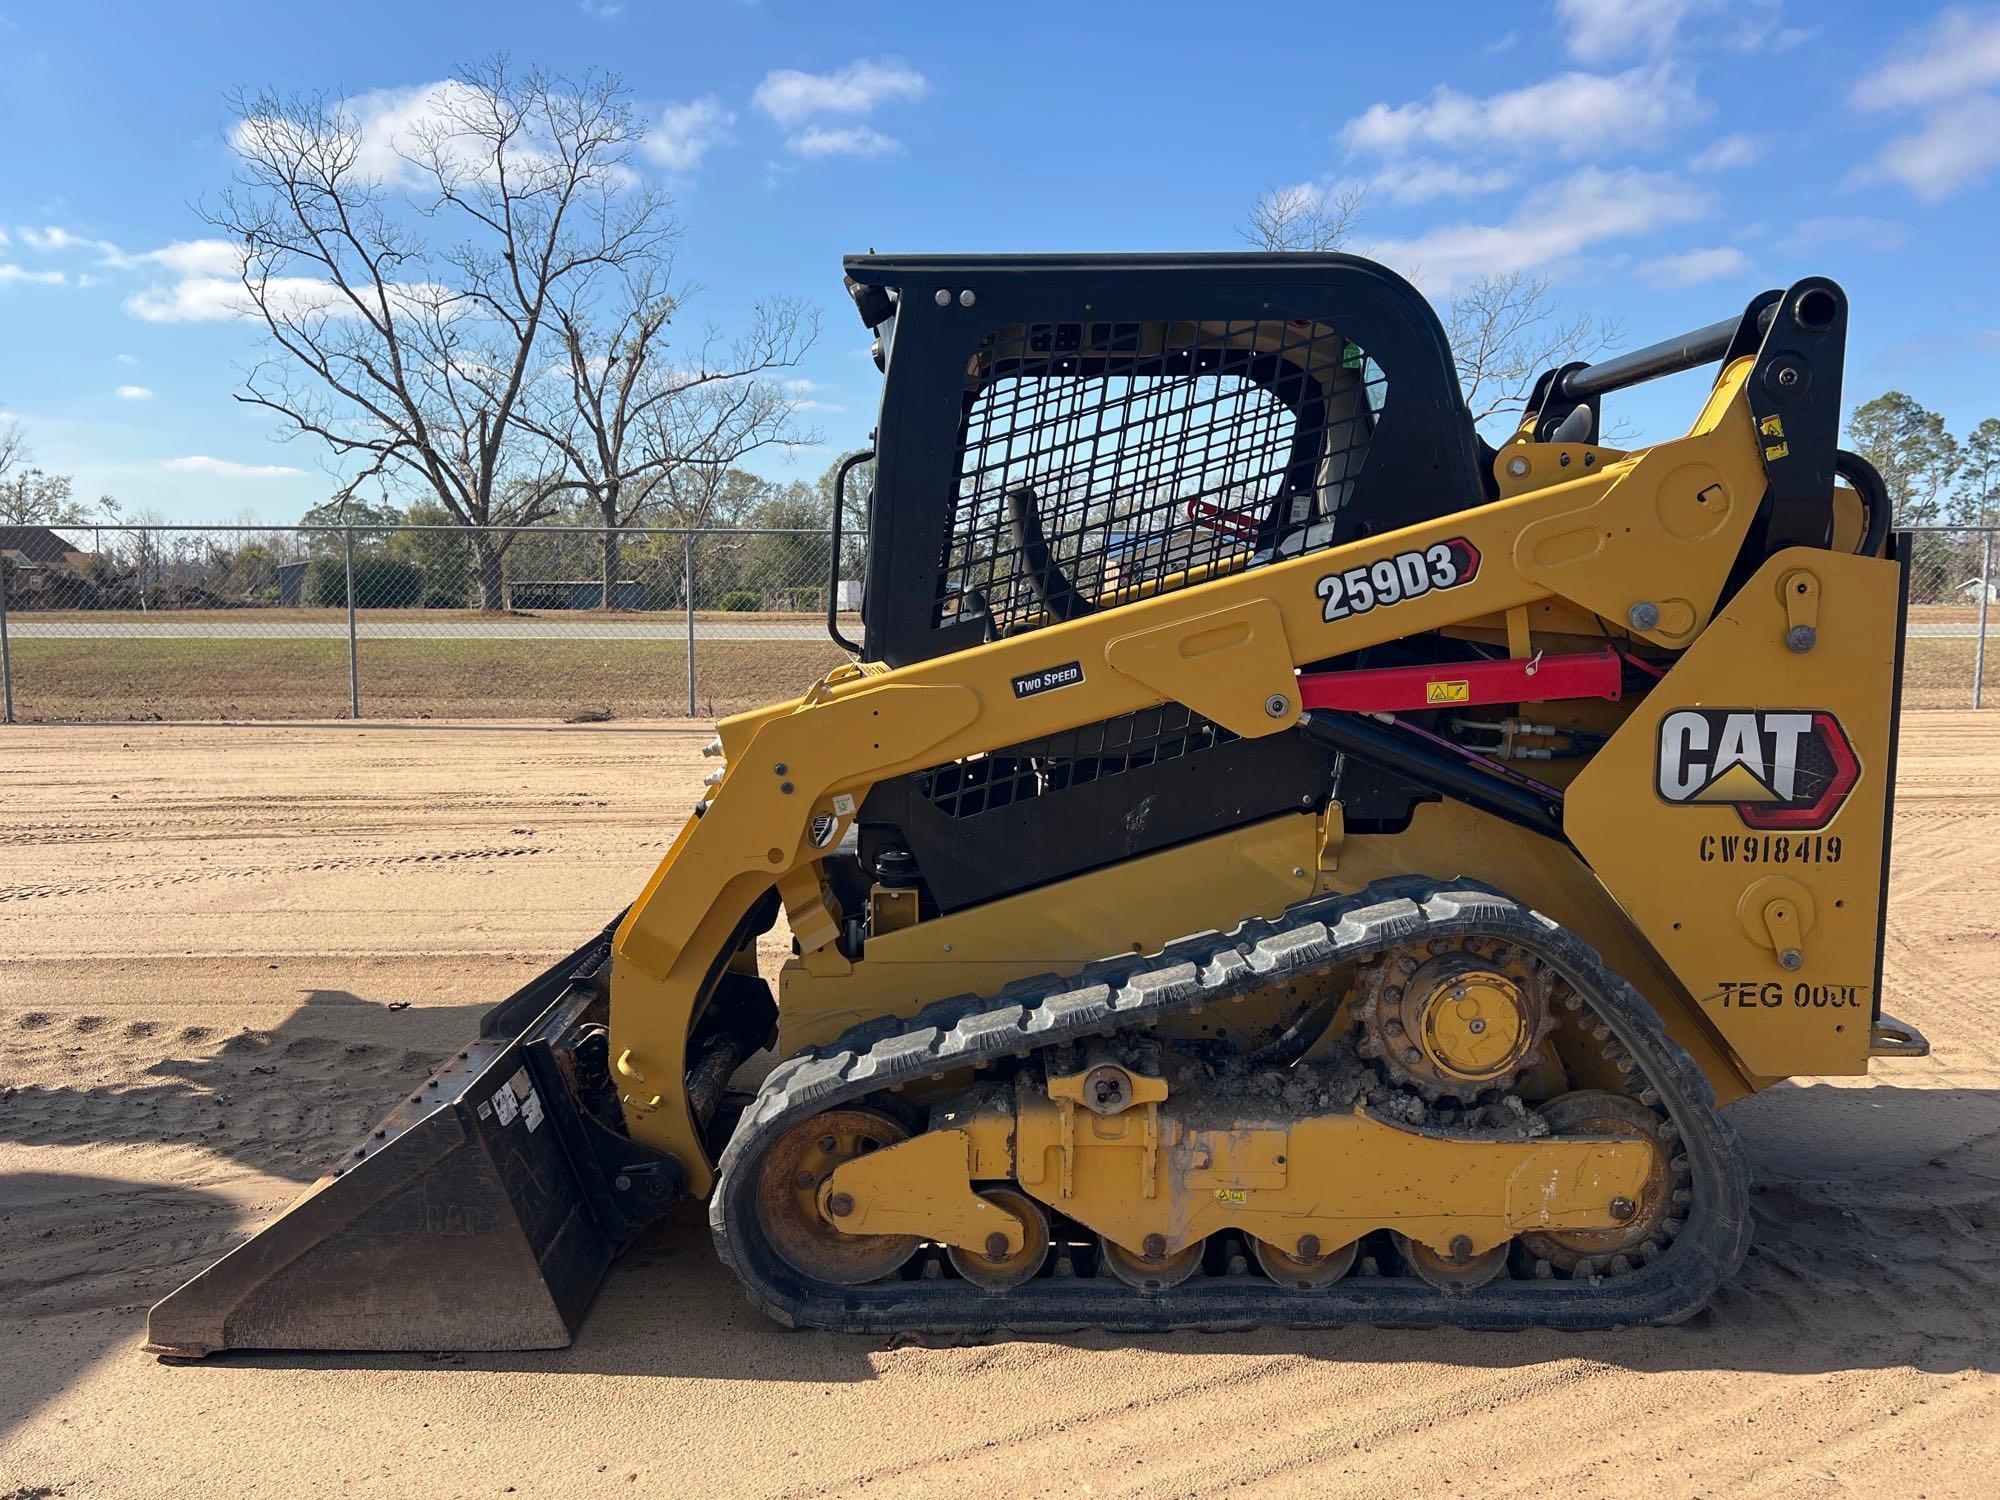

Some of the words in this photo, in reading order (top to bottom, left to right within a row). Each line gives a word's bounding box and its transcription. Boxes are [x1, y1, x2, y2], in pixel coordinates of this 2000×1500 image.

[1318, 544, 1457, 620] 259D3
[1660, 712, 1813, 801] CAT
[1700, 836, 1842, 863] CW918419
[1719, 983, 1783, 1008] TEG
